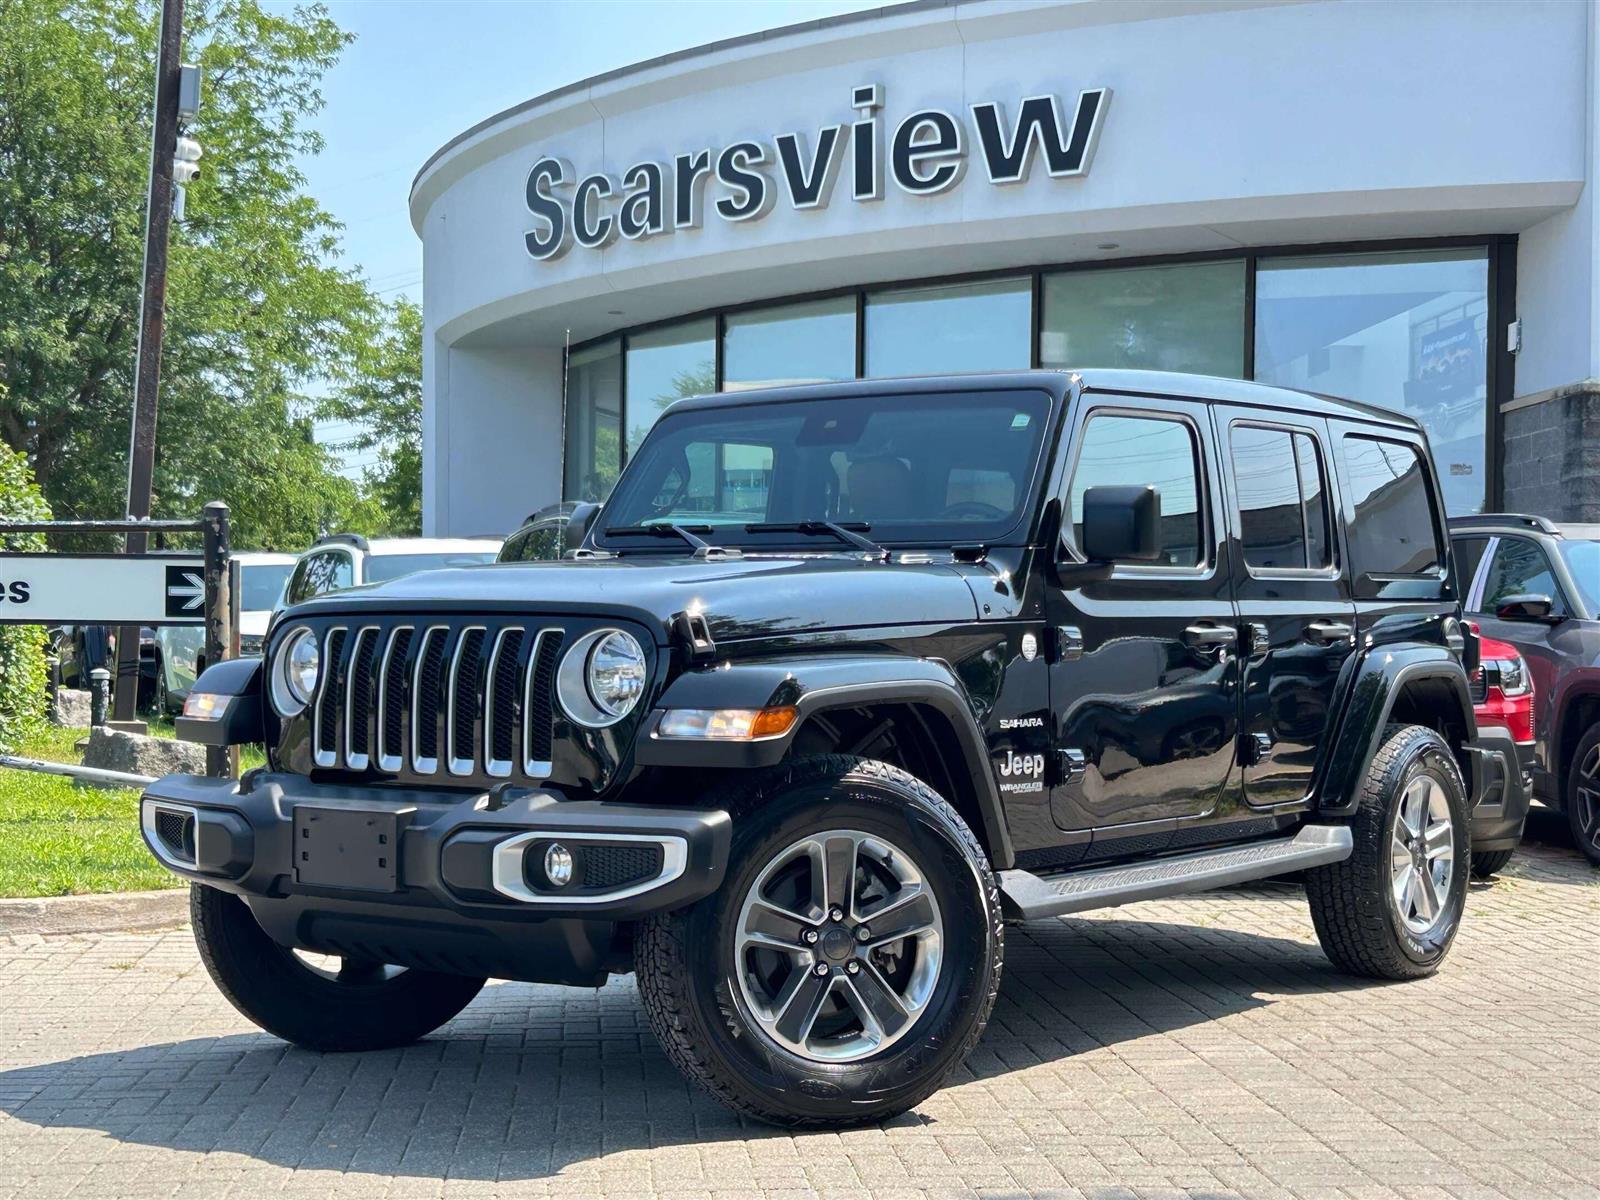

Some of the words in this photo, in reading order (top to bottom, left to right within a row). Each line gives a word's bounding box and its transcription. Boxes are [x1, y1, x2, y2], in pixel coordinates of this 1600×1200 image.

[524, 83, 1109, 261] Scarsview
[0, 581, 30, 603] s
[1000, 718, 1043, 728] SAHARA
[1000, 751, 1044, 778] Jeep
